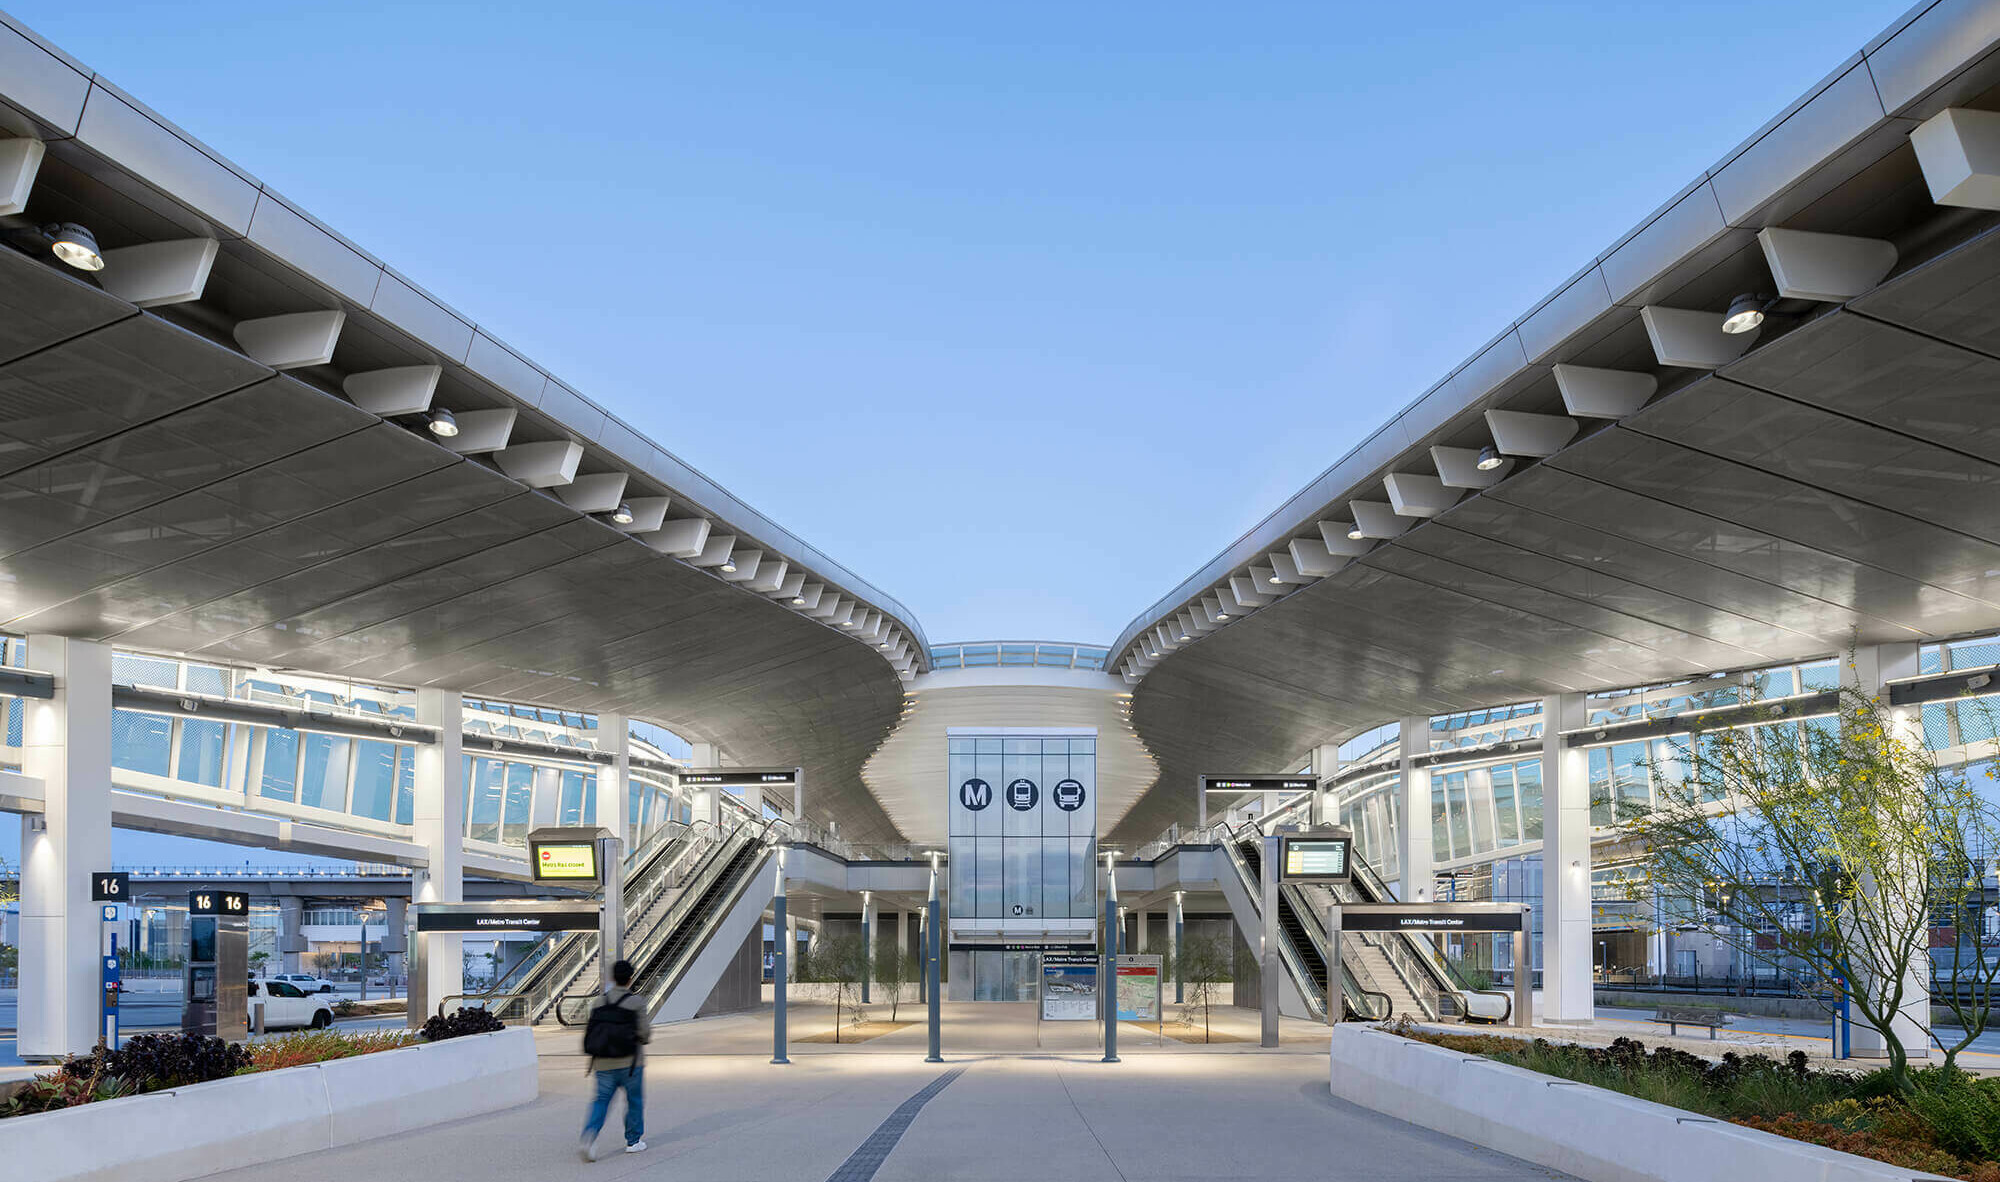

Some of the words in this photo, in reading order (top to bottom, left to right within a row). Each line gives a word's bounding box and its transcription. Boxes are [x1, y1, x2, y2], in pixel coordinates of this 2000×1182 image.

[101, 878, 120, 895] 16
[196, 895, 212, 909] 16
[225, 896, 242, 910] 16
[476, 918, 505, 926] LAX/Metro
[505, 918, 523, 926] Transit
[523, 918, 541, 926] Center
[1400, 918, 1429, 926] LAX/Metro
[1429, 918, 1446, 926] Transit
[1446, 918, 1464, 926] Center
[1067, 955, 1082, 963] Transit
